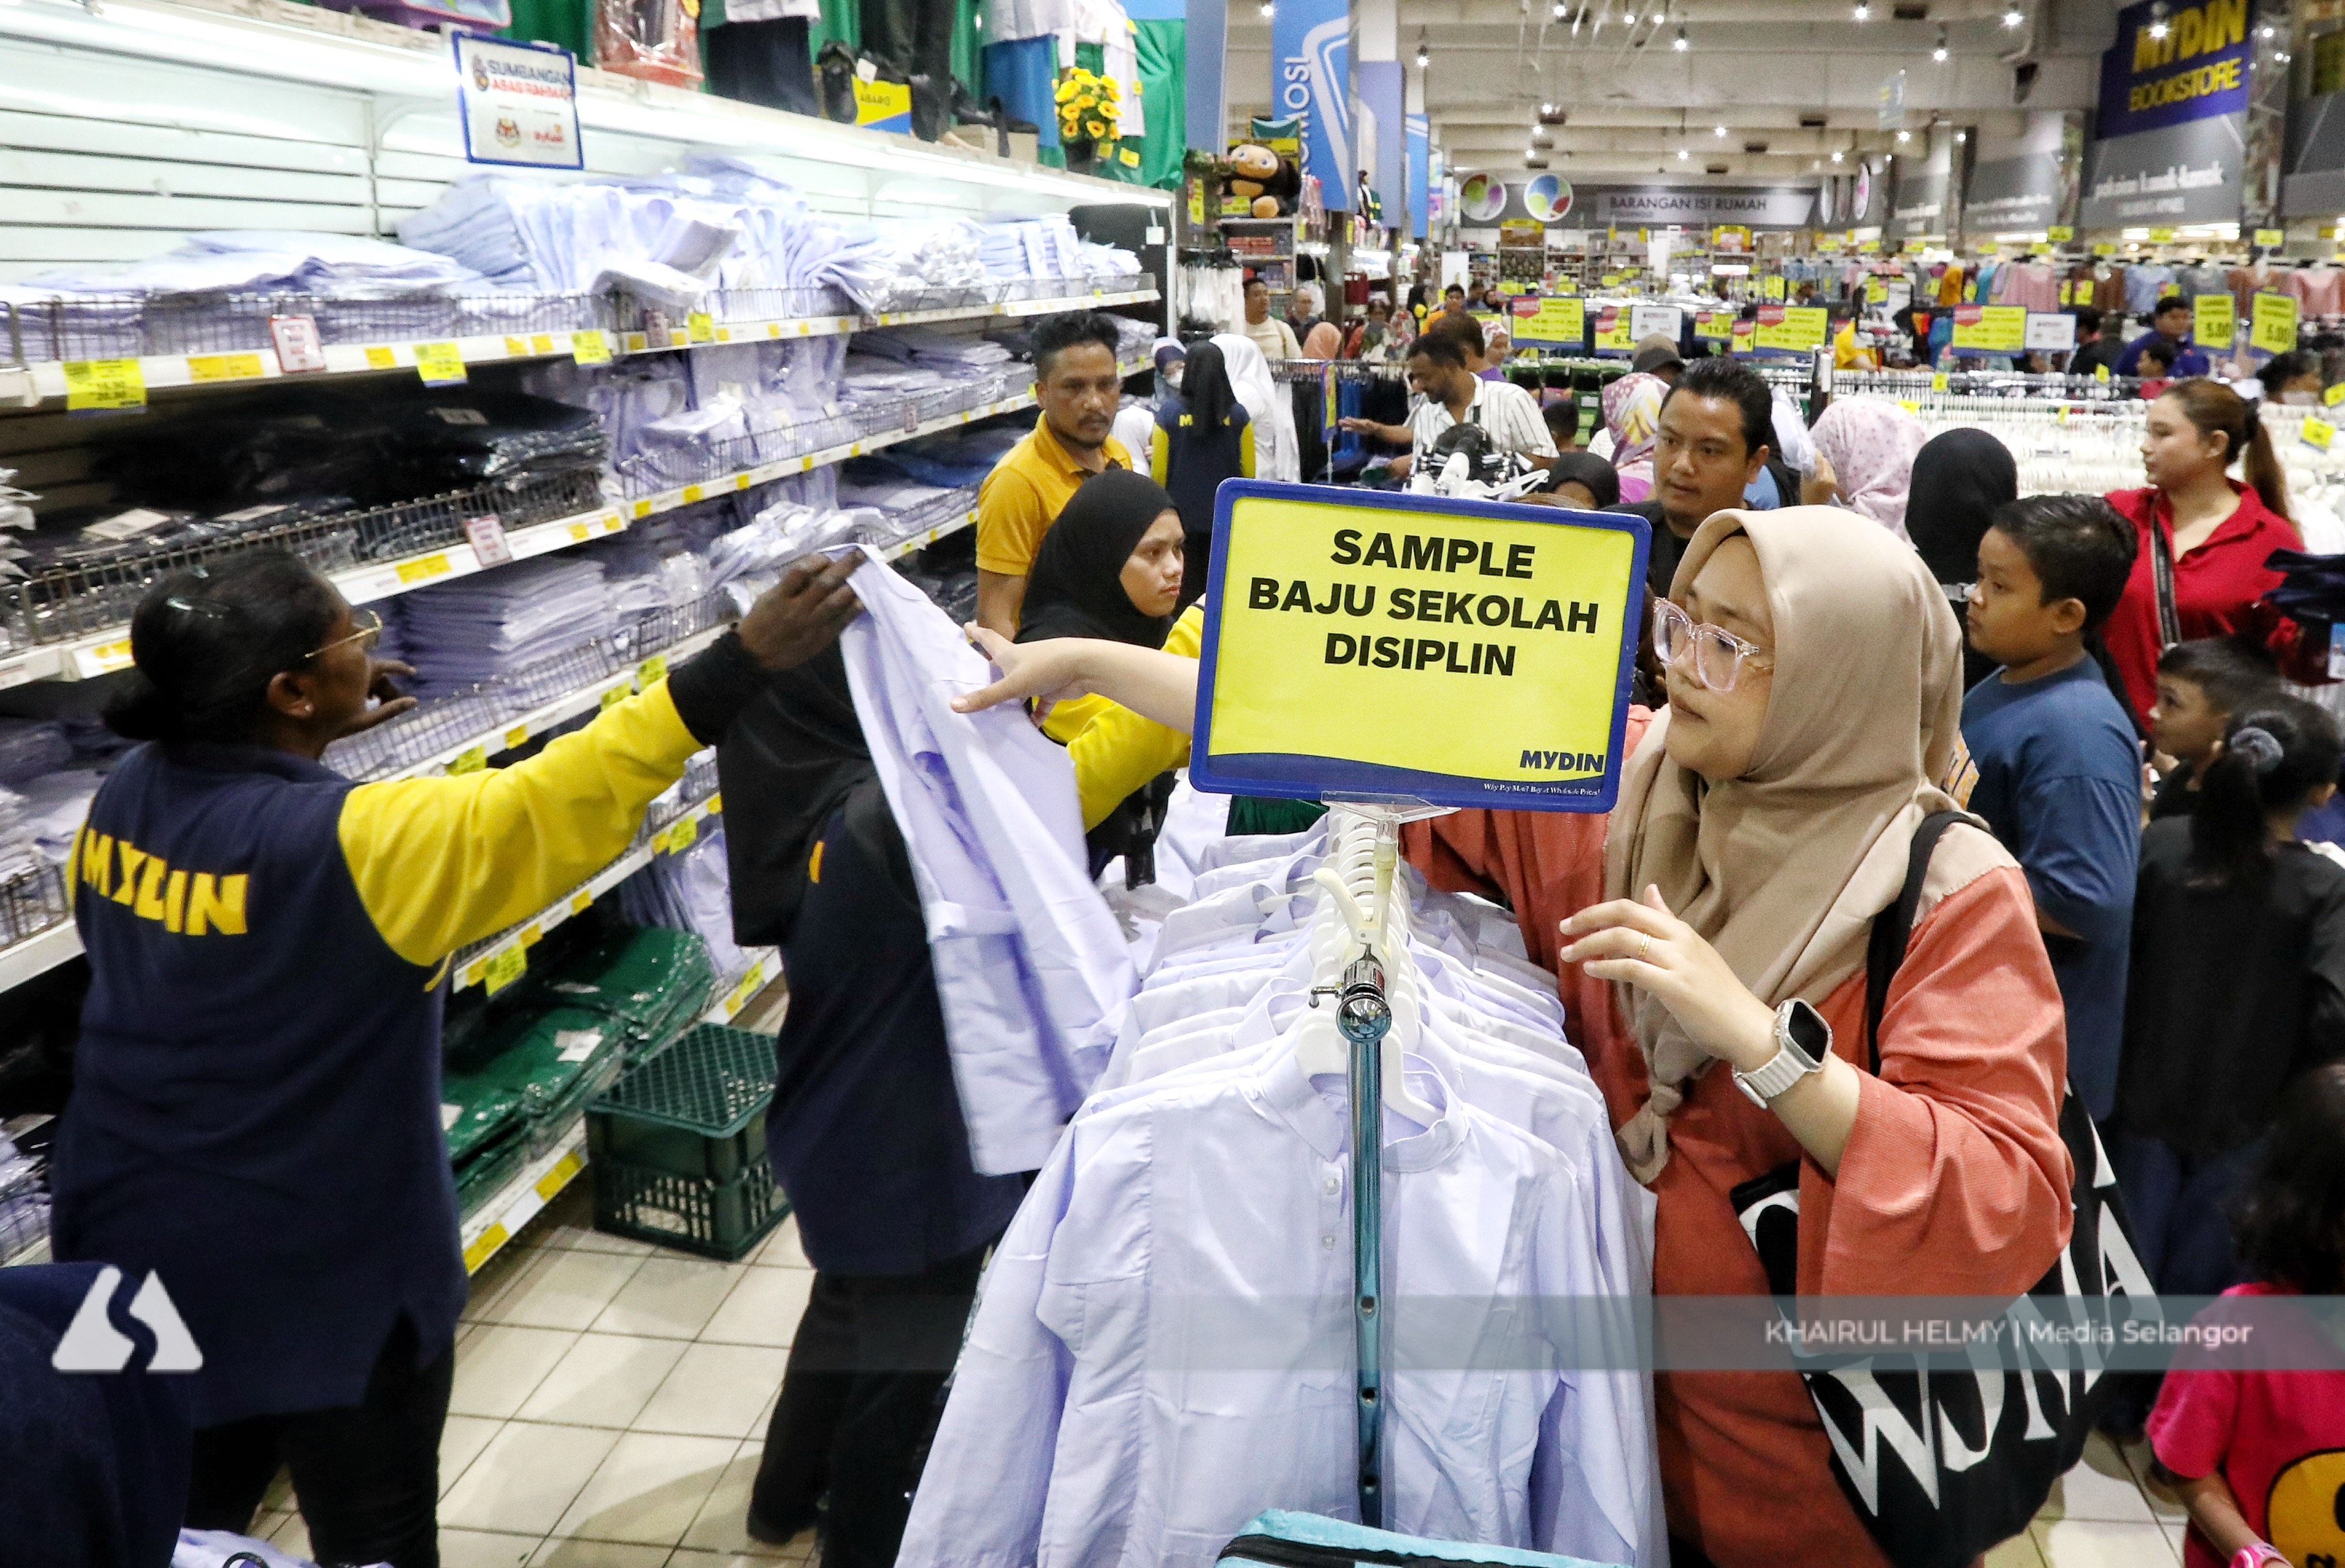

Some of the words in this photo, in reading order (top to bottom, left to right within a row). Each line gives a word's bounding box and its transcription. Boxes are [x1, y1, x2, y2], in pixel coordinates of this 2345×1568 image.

[2132, 0, 2247, 73] MYDIN
[2129, 57, 2243, 112] BOOKSTORE
[1610, 196, 1691, 210] BARANGAN
[1694, 197, 1712, 209] ISI
[1716, 197, 1767, 211] RUMAH
[1331, 530, 1535, 579] SAMPLE
[1249, 578, 1376, 616] BAJU
[1387, 589, 1599, 634] SEKOLAH
[1325, 633, 1516, 676] DISIPLIN
[1520, 750, 1604, 773] MYDIN
